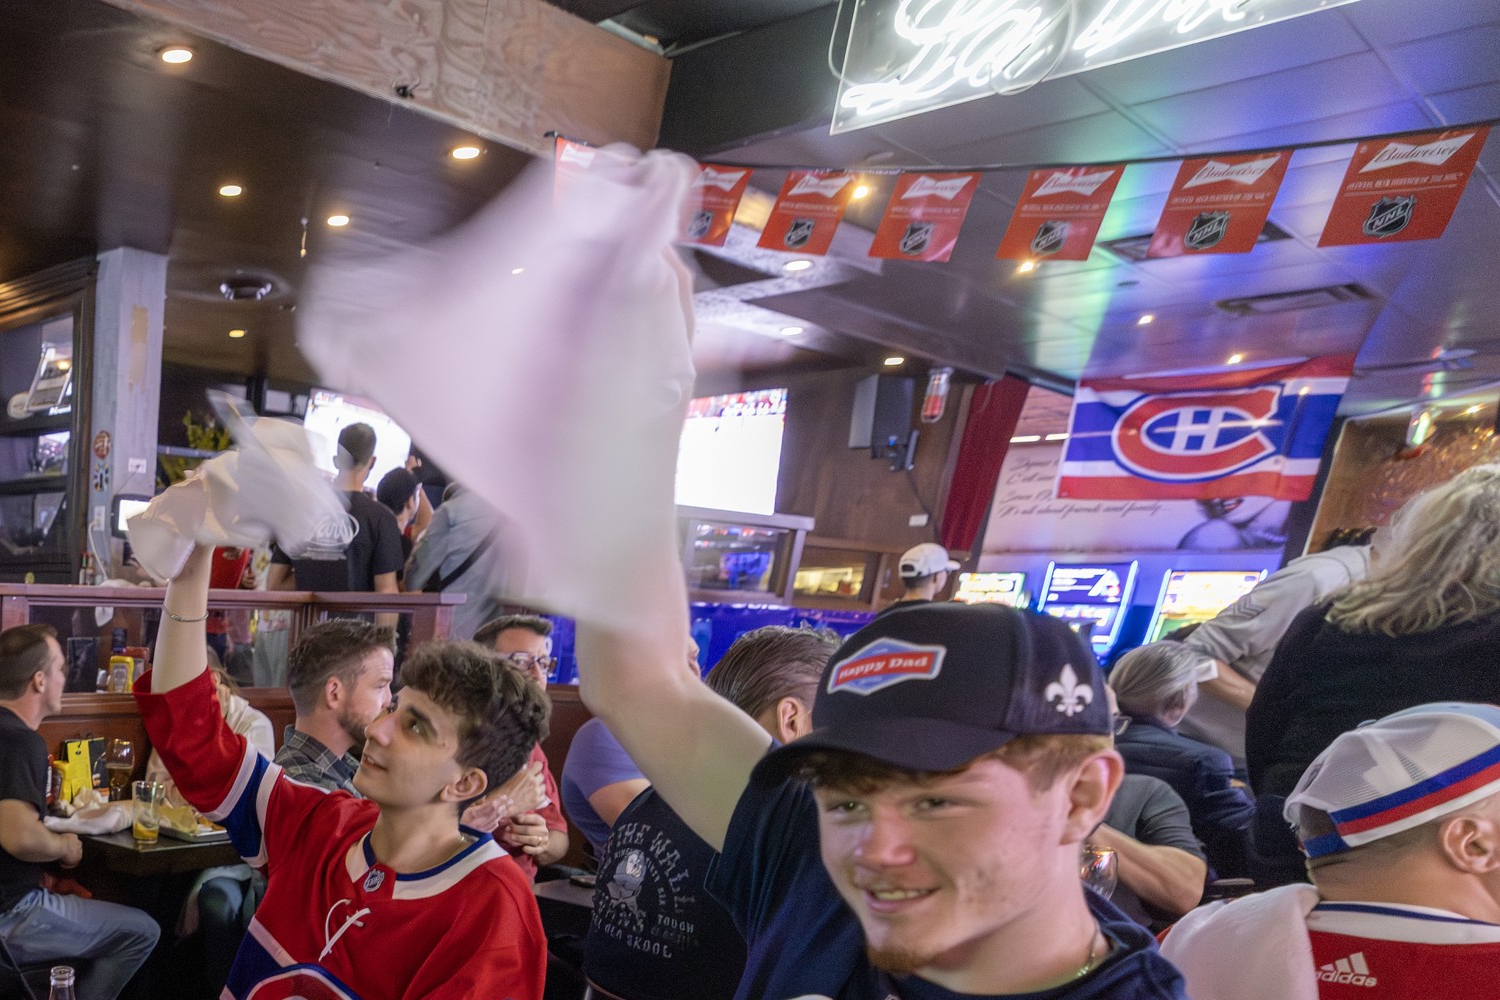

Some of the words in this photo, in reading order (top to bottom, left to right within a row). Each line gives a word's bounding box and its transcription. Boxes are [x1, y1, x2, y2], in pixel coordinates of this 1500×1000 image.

[1373, 143, 1459, 163] Budweiser
[1372, 204, 1408, 231] NHL
[839, 661, 887, 680] Happy
[888, 656, 929, 669] Dad
